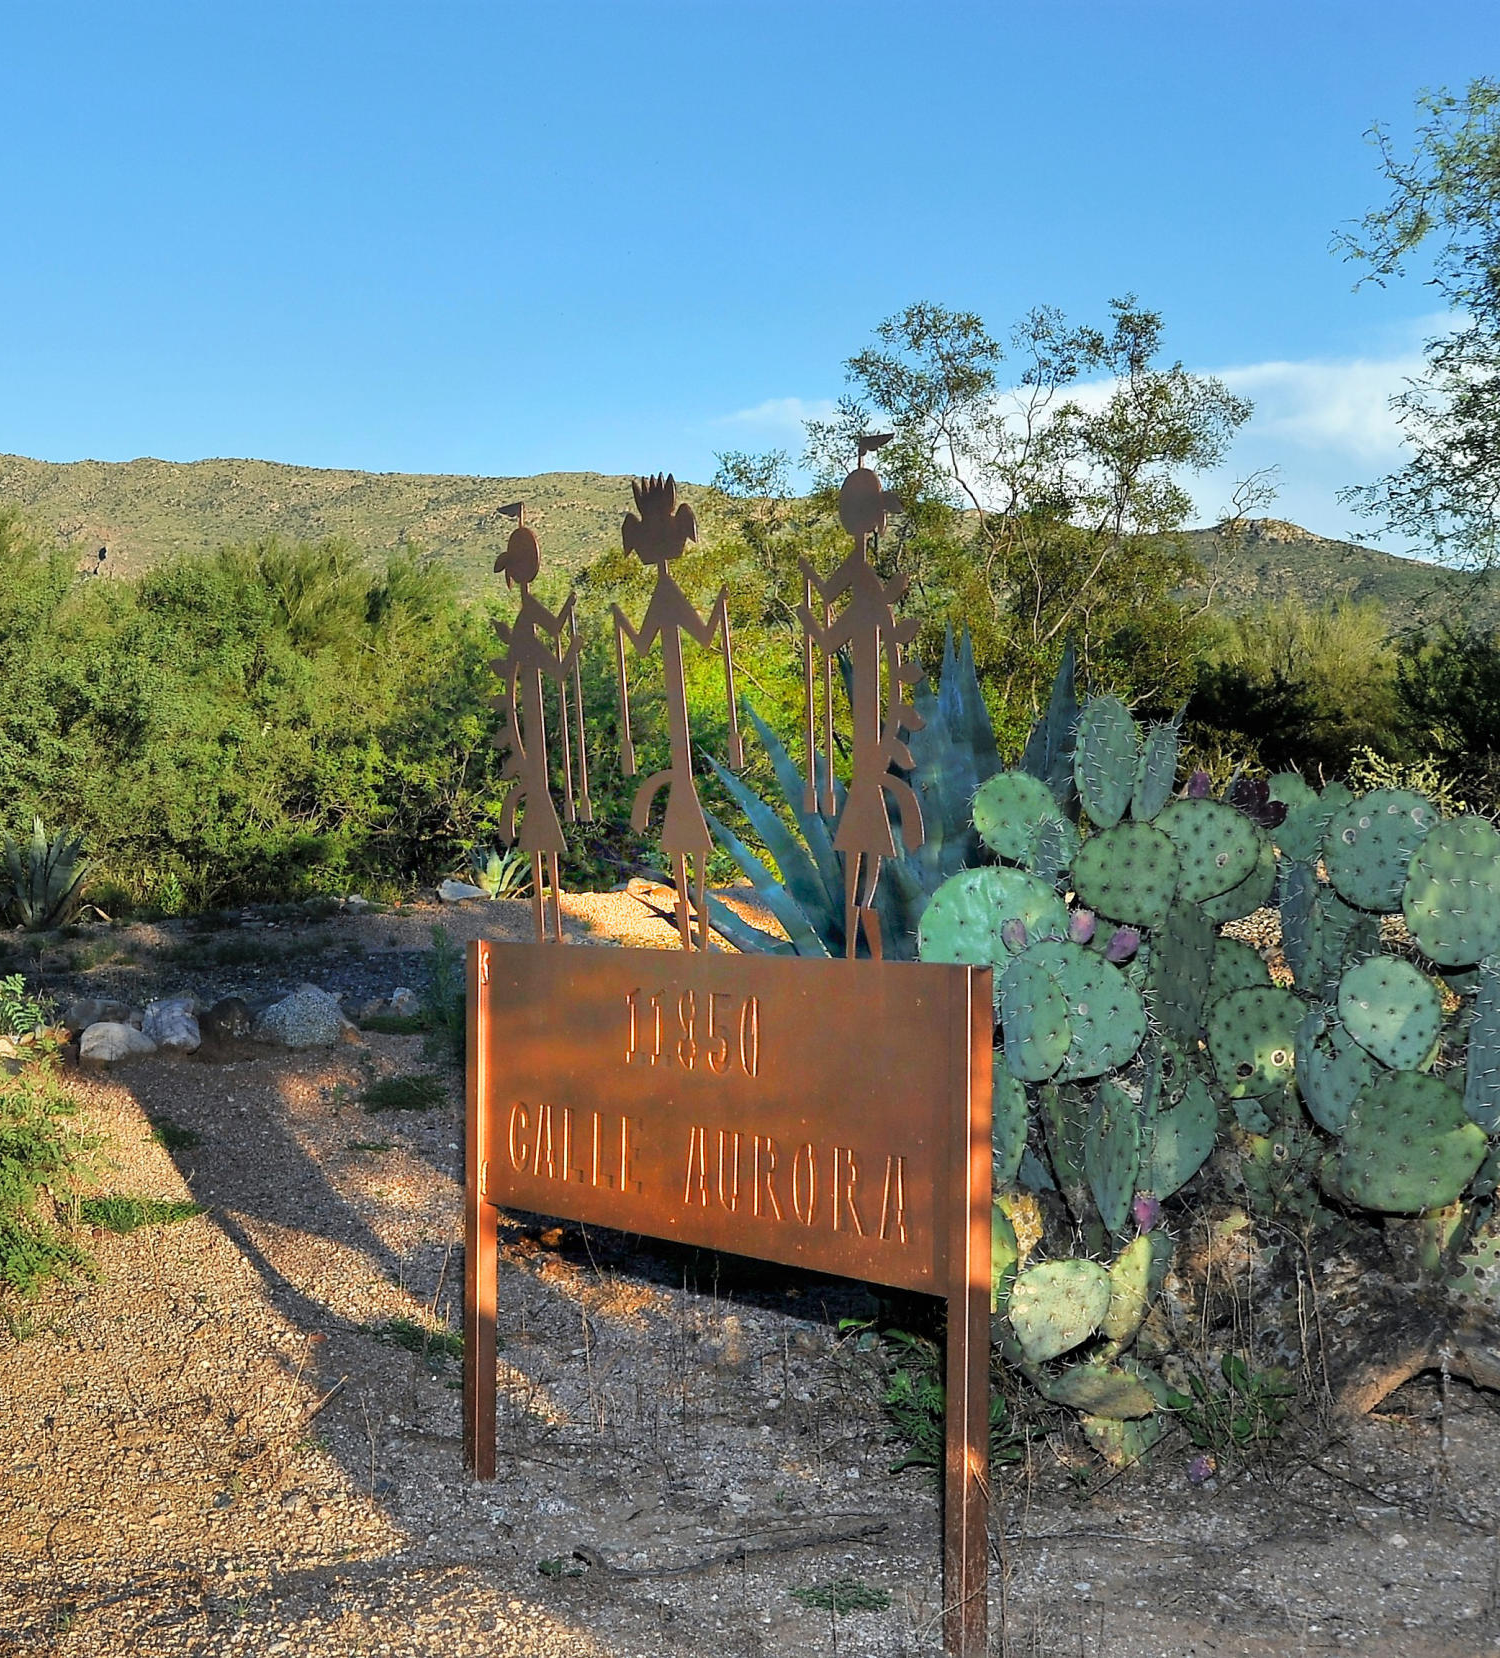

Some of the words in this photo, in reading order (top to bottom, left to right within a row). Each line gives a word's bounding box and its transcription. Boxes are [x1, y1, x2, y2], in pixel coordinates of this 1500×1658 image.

[625, 987, 760, 1078] 11850
[508, 1101, 644, 1194] CALLE
[683, 1126, 908, 1244] AURORA
